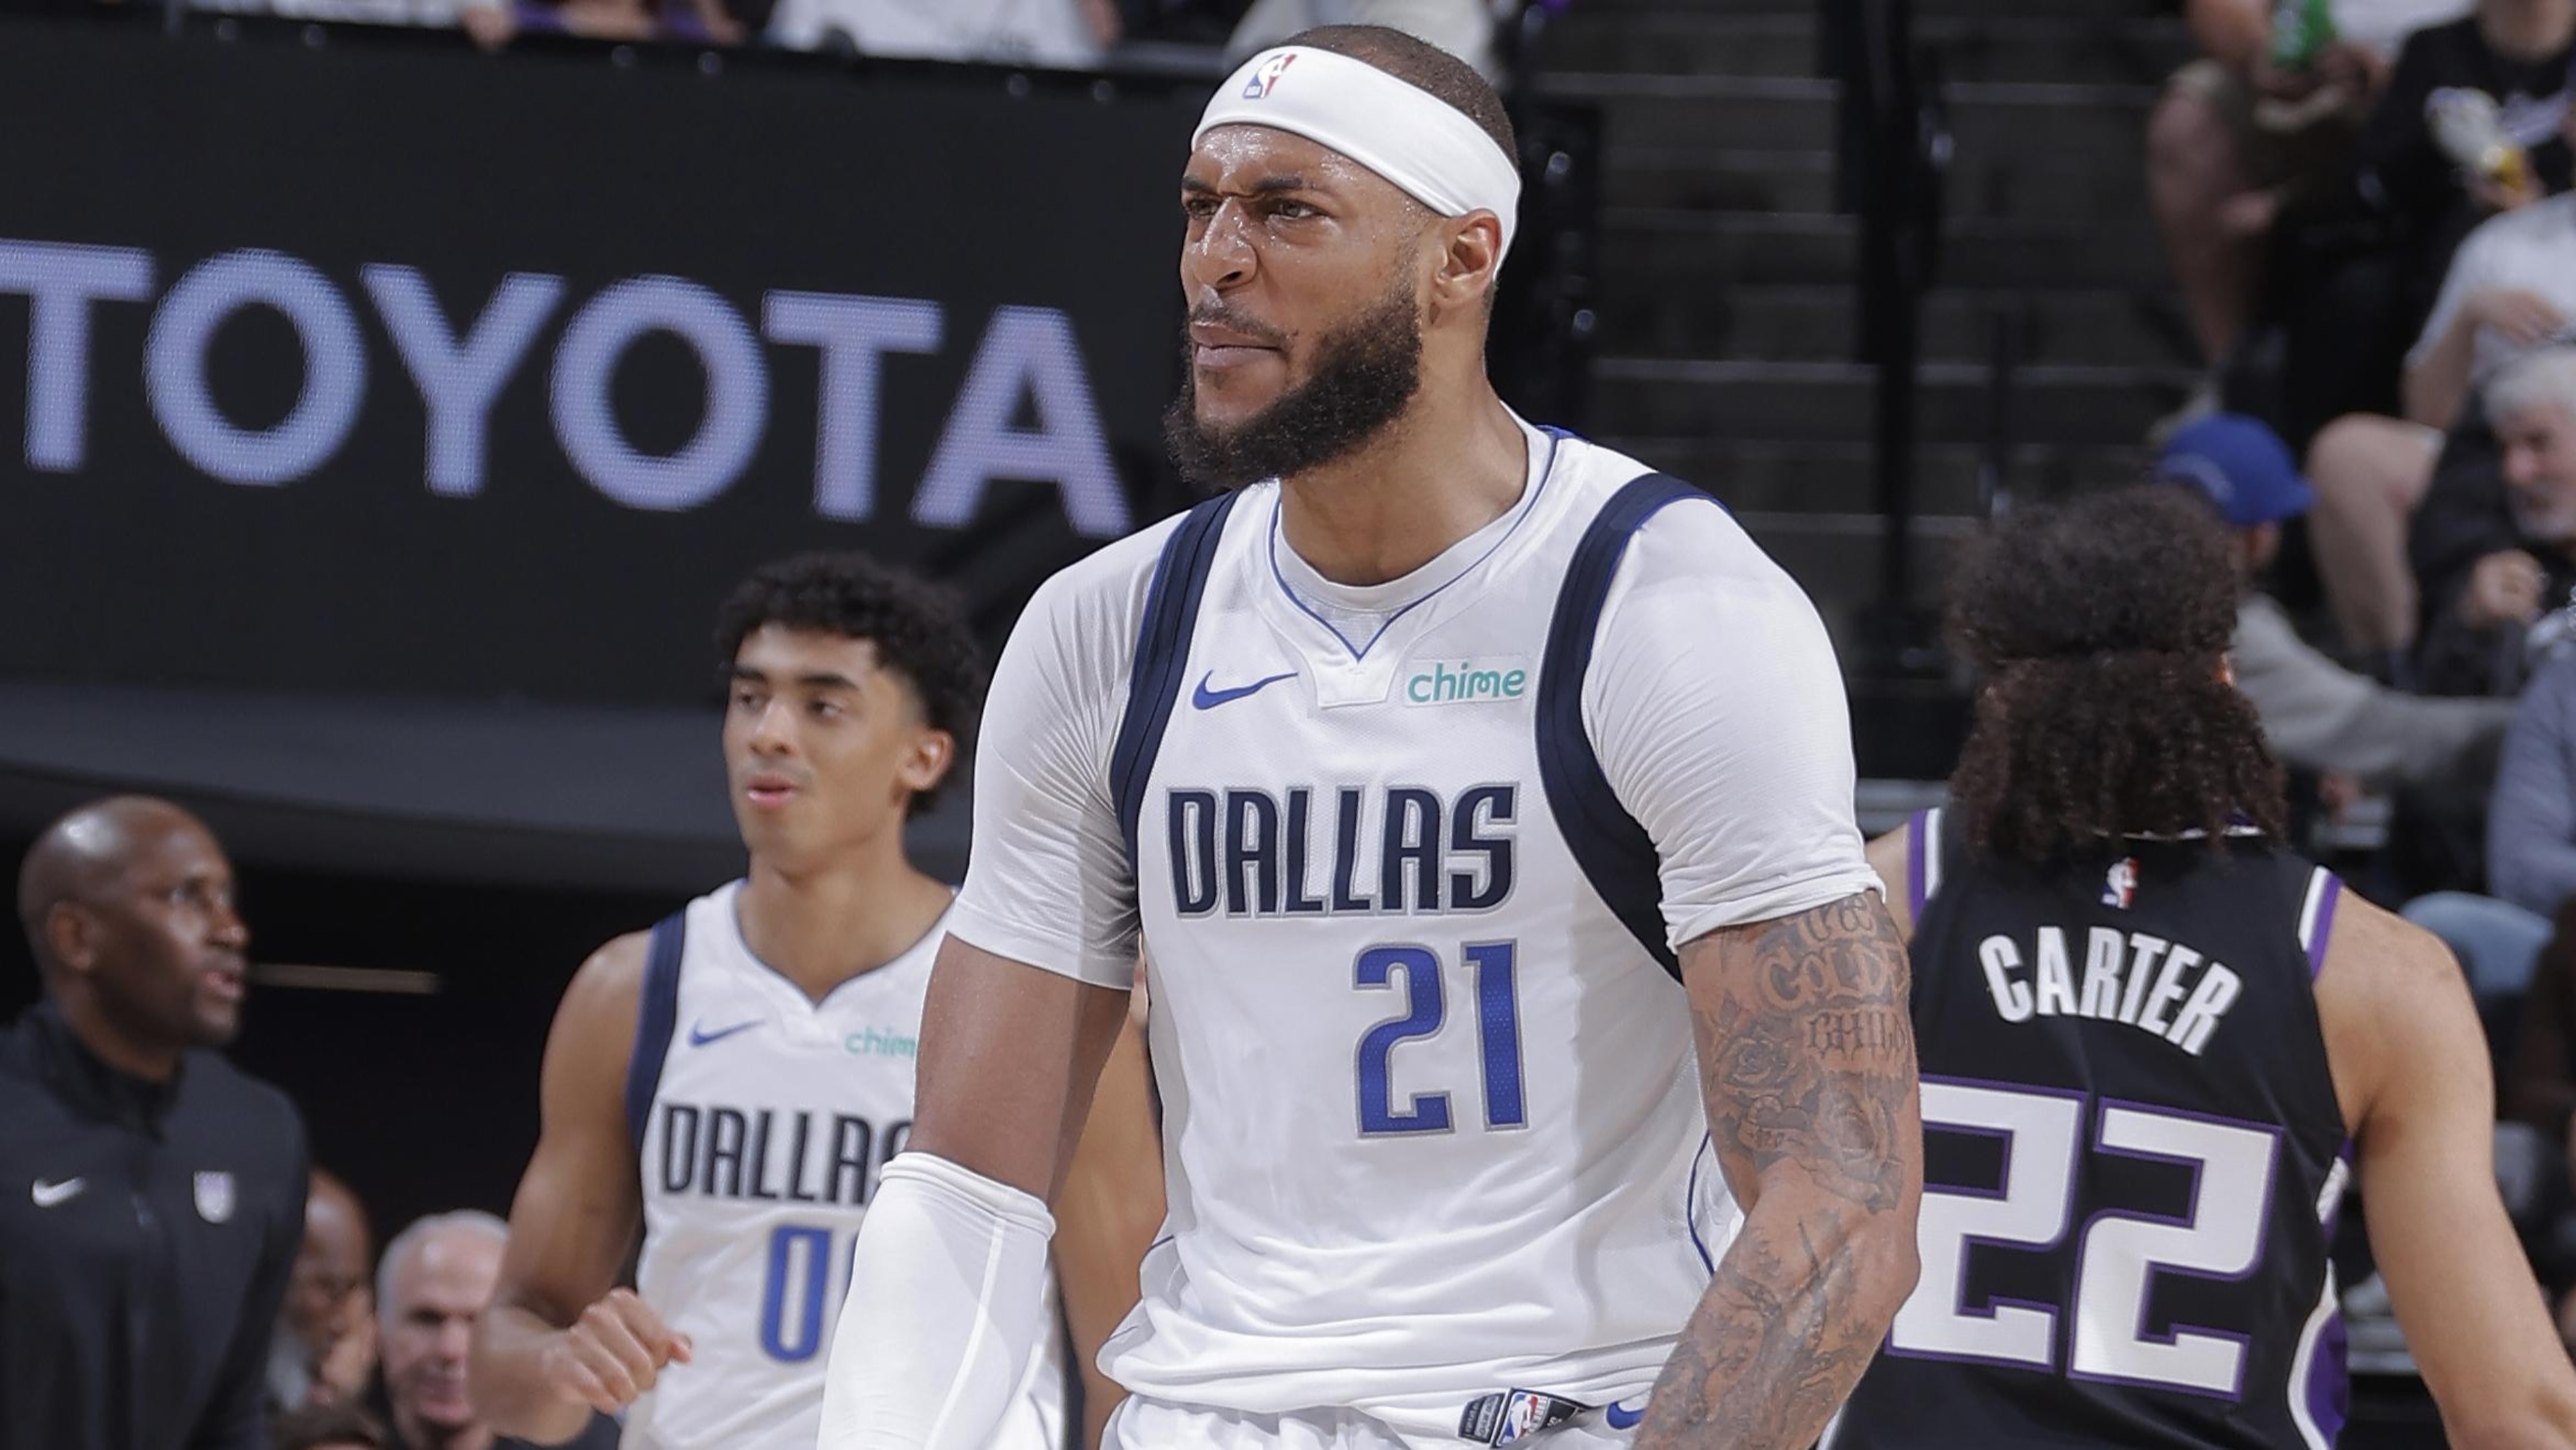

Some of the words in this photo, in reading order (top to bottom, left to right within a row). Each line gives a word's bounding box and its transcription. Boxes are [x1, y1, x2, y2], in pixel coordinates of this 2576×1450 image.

[0, 238, 1131, 539] TOYOTA
[1408, 662, 1525, 703] chime
[1165, 782, 1521, 919] DALLAS
[843, 1026, 916, 1057] chim
[1352, 938, 1529, 1139] 21
[1978, 926, 2243, 1055] CARTER
[760, 1223, 858, 1363] 0
[1884, 1075, 2284, 1403] 22
